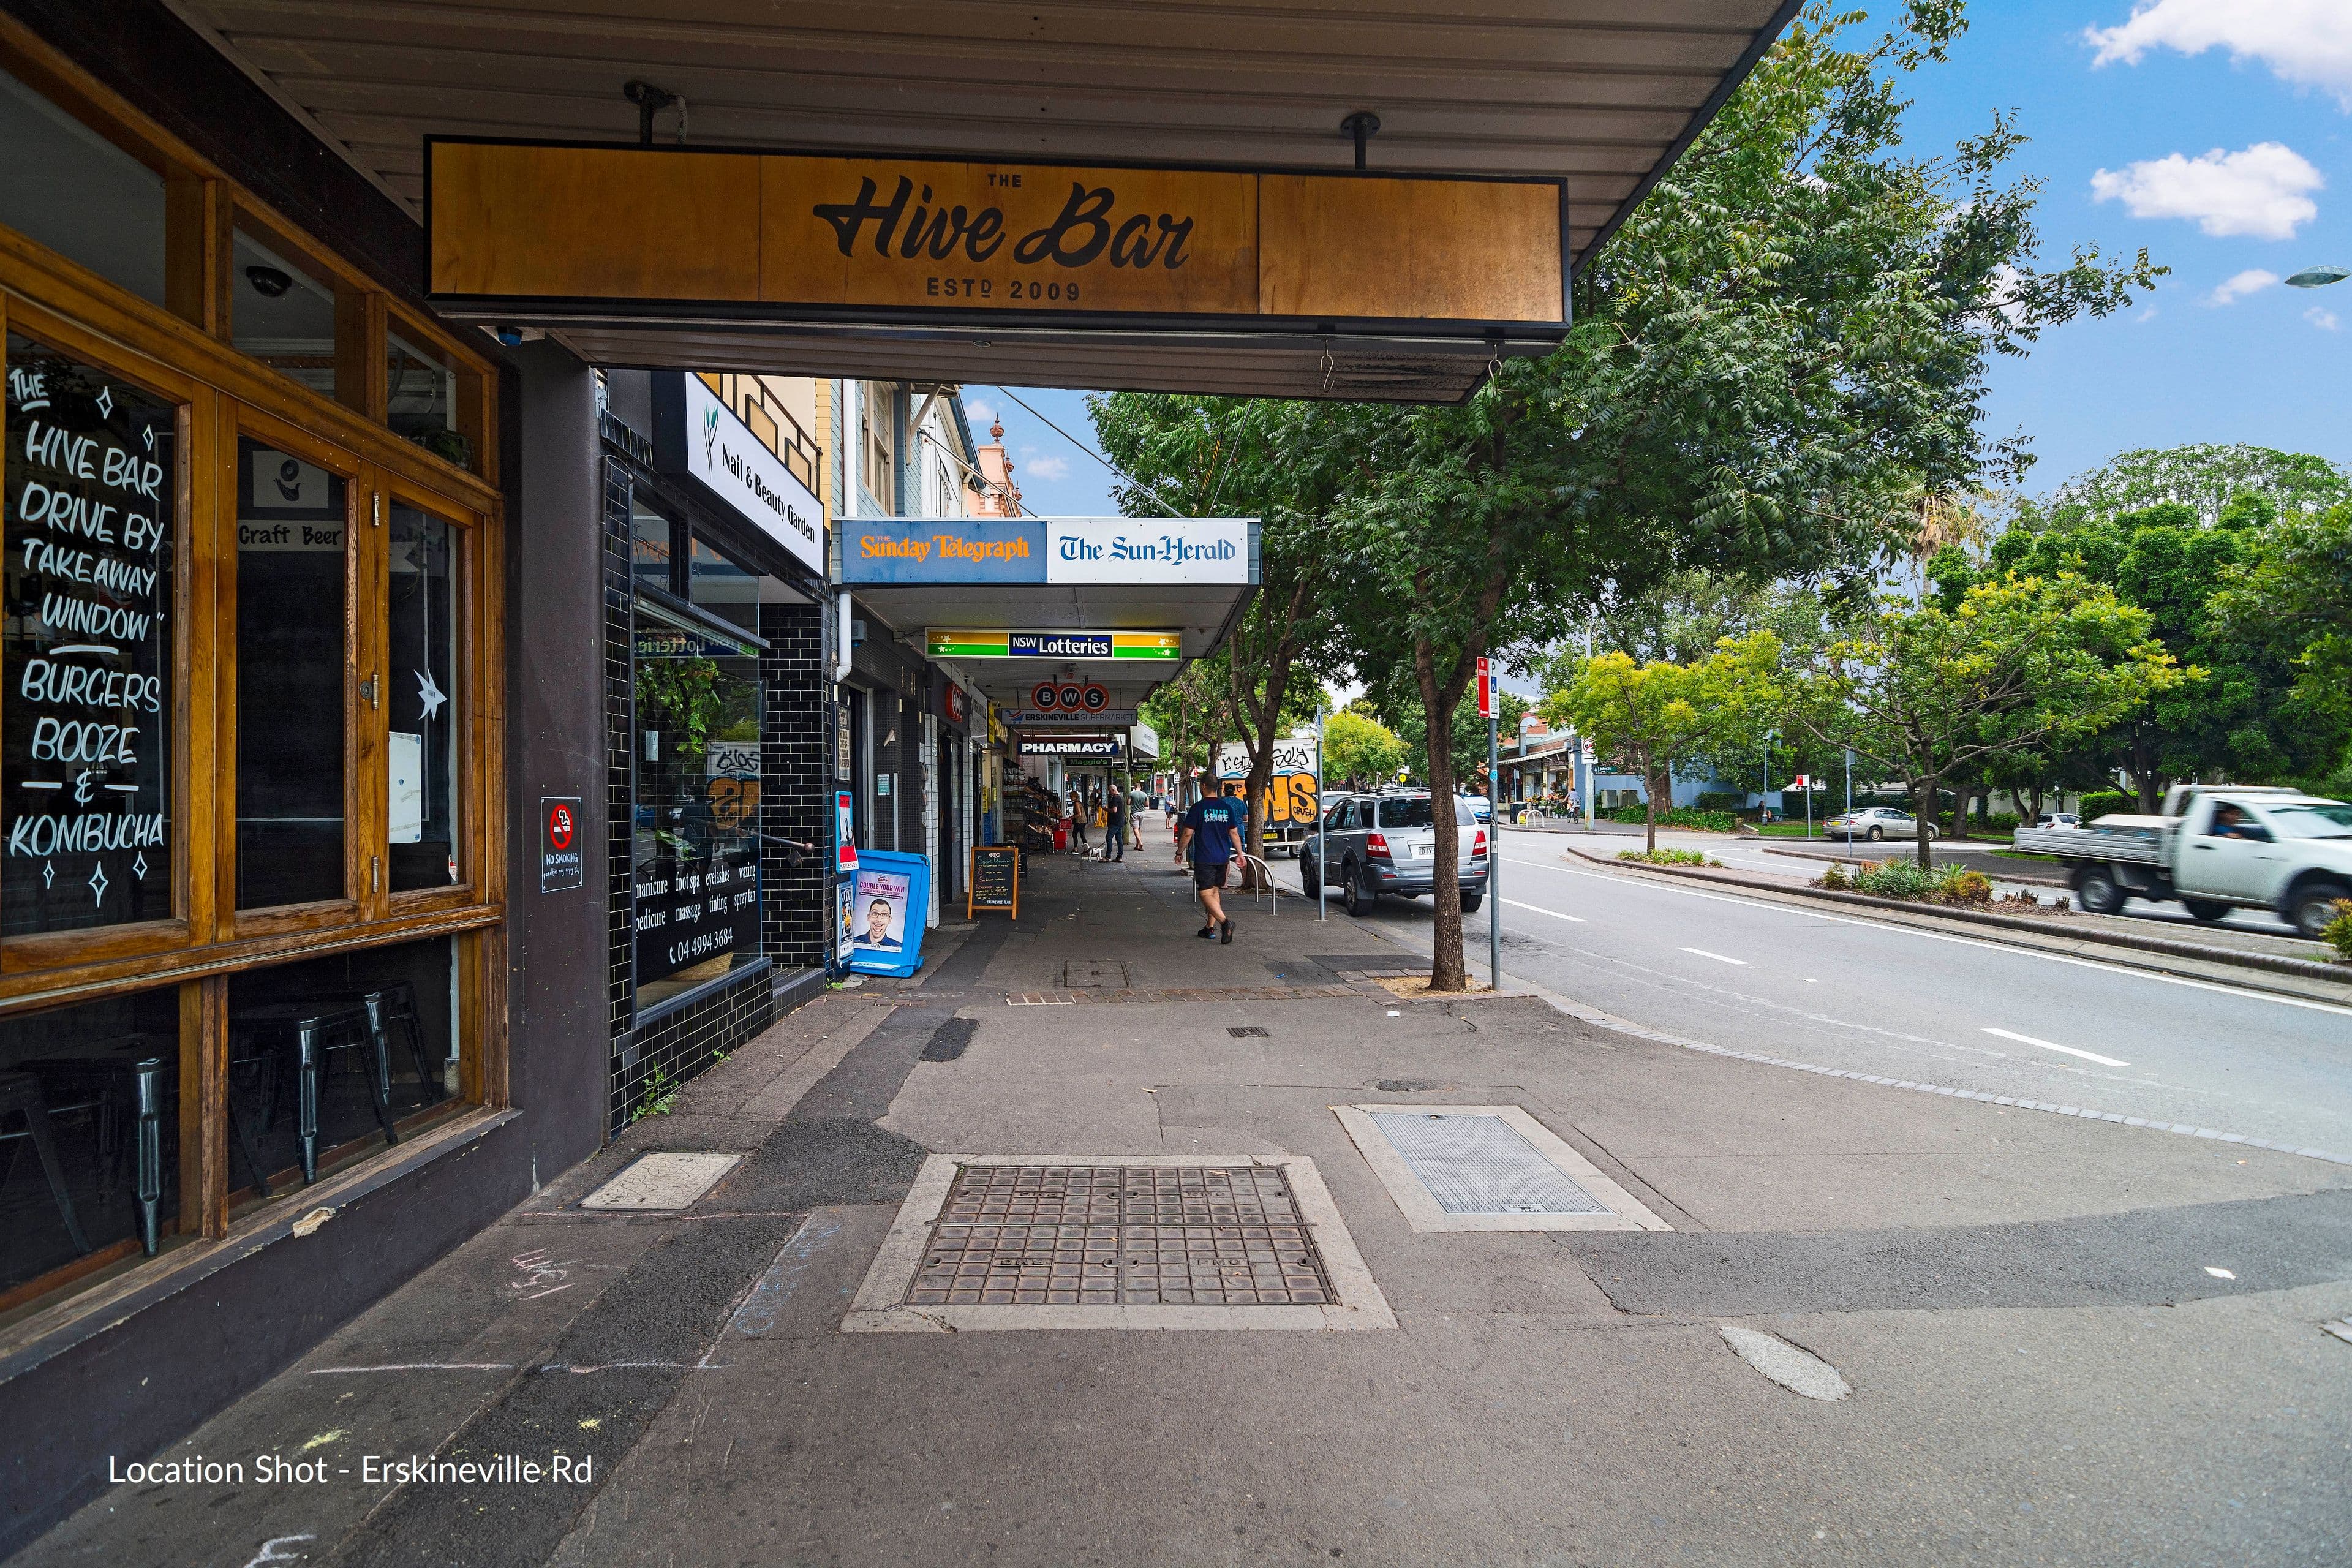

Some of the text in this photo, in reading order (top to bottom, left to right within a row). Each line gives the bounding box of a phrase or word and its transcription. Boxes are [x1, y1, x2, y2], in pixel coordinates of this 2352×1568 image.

[987, 173, 1022, 187] THE
[813, 175, 1194, 270] Hive Bar
[1009, 280, 1080, 301] 2009
[9, 369, 50, 401] THE
[26, 421, 163, 502] HIVE BAR
[722, 442, 815, 544] Nail & Beauty Garden
[20, 482, 164, 552] DRIVE BY
[239, 524, 342, 548] Craft Beer
[861, 535, 1030, 562] Sunday Telegraph
[1058, 535, 1236, 565] The Sun-Herald
[22, 538, 157, 598] TAKEAWAY
[1012, 636, 1109, 655] NSW Lotteries
[22, 660, 162, 713] BURGERS
[32, 718, 140, 764] BOOZE
[1022, 742, 1115, 753] PHARMACY
[10, 813, 164, 858] KOMBUCHA
[546, 852, 578, 865] NO SMOKING
[739, 862, 756, 881] waxing
[676, 872, 700, 894] foot spa
[706, 865, 730, 891] eyelashes
[676, 902, 701, 923] massage
[709, 893, 727, 914] tinting
[734, 892, 747, 911] spray
[677, 926, 733, 962] 04 4994 3684
